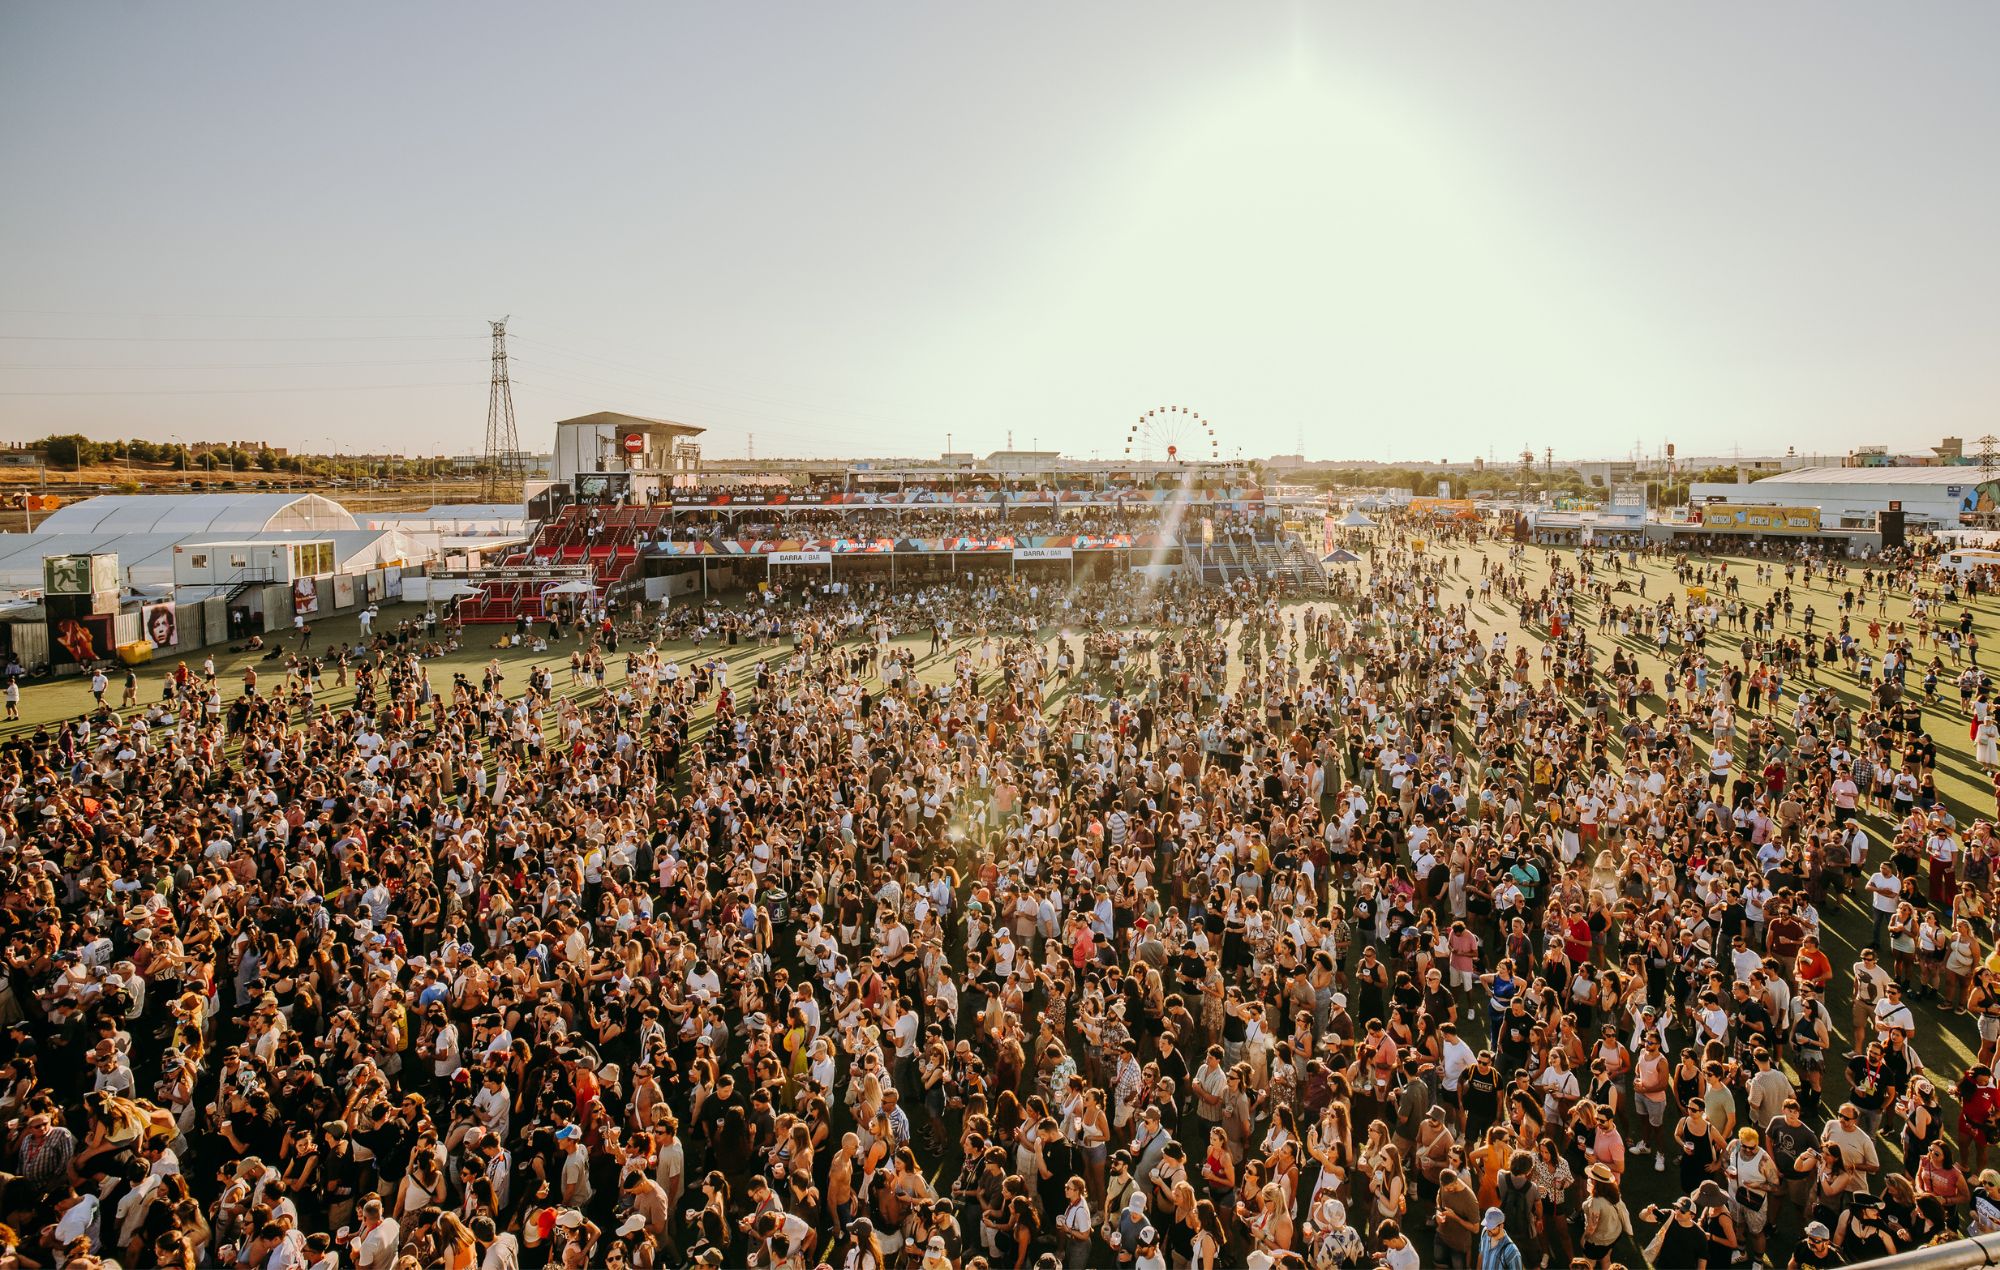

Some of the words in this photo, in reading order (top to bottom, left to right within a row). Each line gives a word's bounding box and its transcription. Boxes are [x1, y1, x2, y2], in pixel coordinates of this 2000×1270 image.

[1614, 498, 1640, 506] CASHLESS
[1711, 515, 1731, 525] MERCH
[1749, 515, 1770, 526] MERCH
[1788, 517, 1810, 527] MERCH
